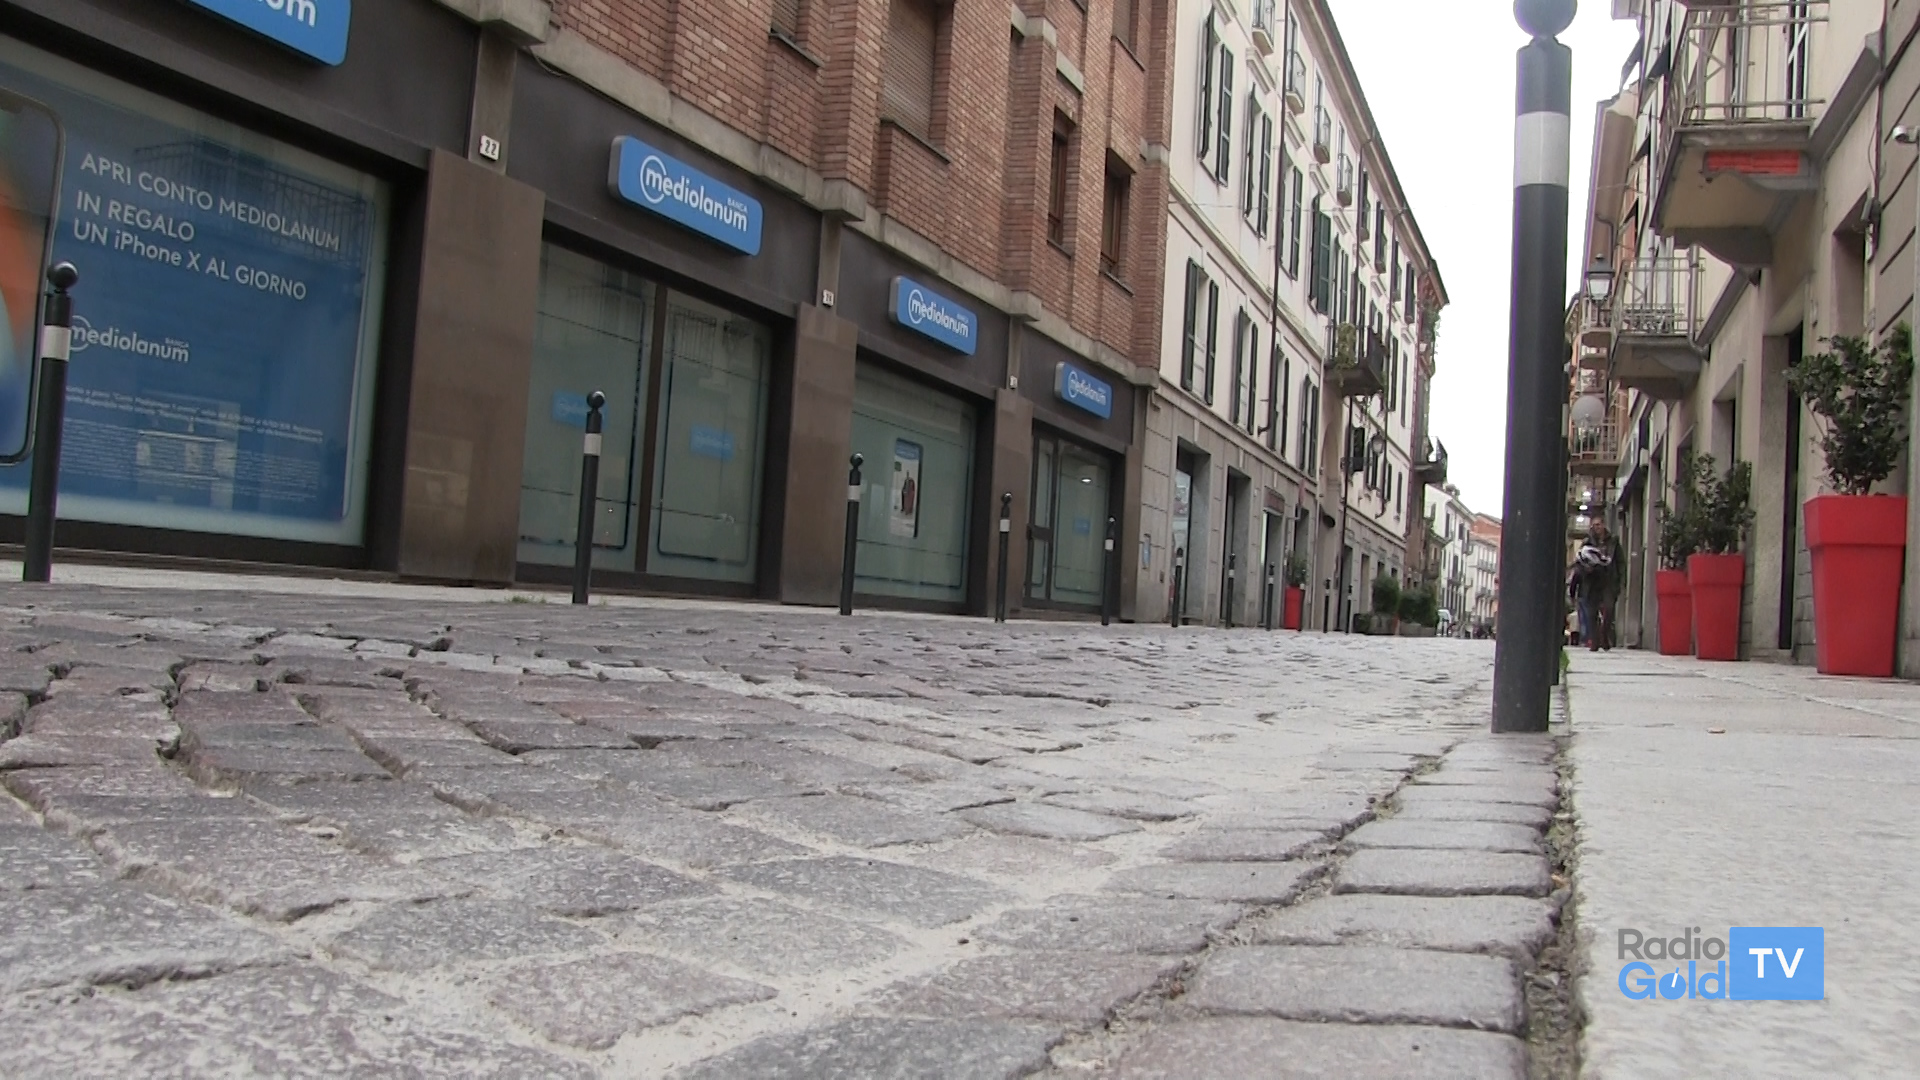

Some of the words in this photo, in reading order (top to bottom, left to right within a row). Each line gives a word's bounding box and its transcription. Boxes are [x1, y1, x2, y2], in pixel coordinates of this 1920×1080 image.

[76, 190, 101, 215] IN
[108, 200, 195, 243] REGALO
[80, 153, 131, 185] APRI
[138, 172, 213, 210] CONTO
[219, 197, 340, 251] MEDIOLANUM
[645, 168, 748, 232] mediolanum
[73, 218, 107, 246] UN
[115, 230, 182, 267] iPhone
[186, 251, 201, 272] X
[206, 260, 230, 280] AL
[235, 265, 307, 300] GIORNO
[71, 325, 189, 363] mediolanum
[911, 299, 969, 338] mediolanum
